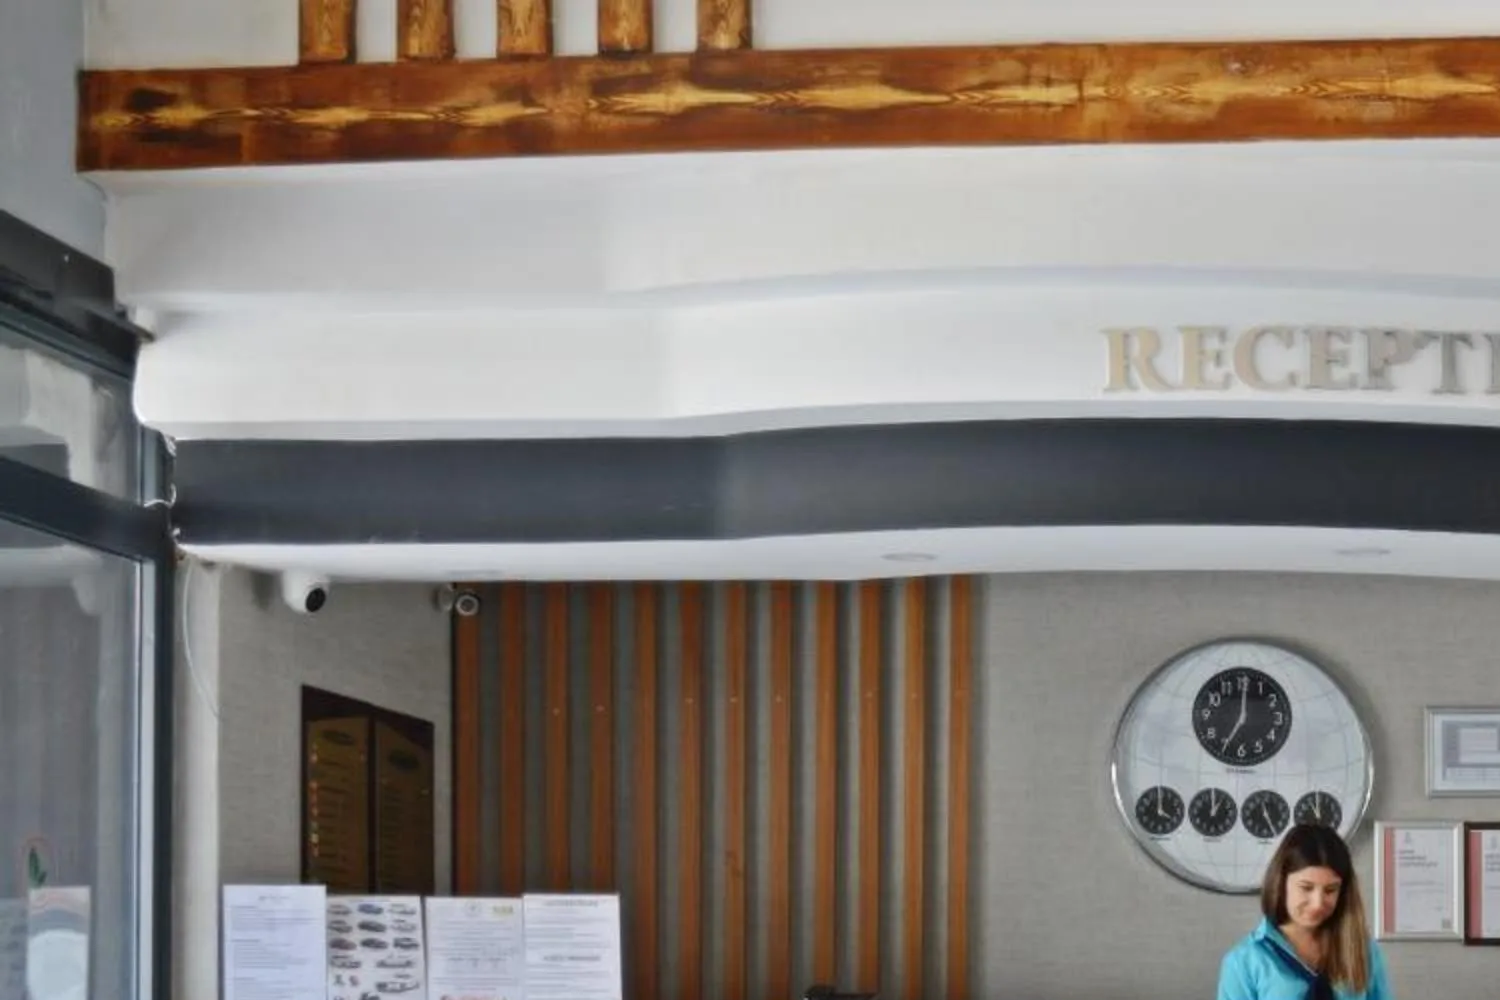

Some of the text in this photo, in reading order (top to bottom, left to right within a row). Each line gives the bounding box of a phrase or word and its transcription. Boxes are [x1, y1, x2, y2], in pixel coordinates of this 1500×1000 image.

[1257, 681, 1263, 696] 1
[1268, 694, 1277, 708] 2
[1273, 711, 1283, 725] 3
[1266, 728, 1275, 743] 4
[1238, 743, 1246, 757] 6
[1253, 740, 1263, 753] 5
